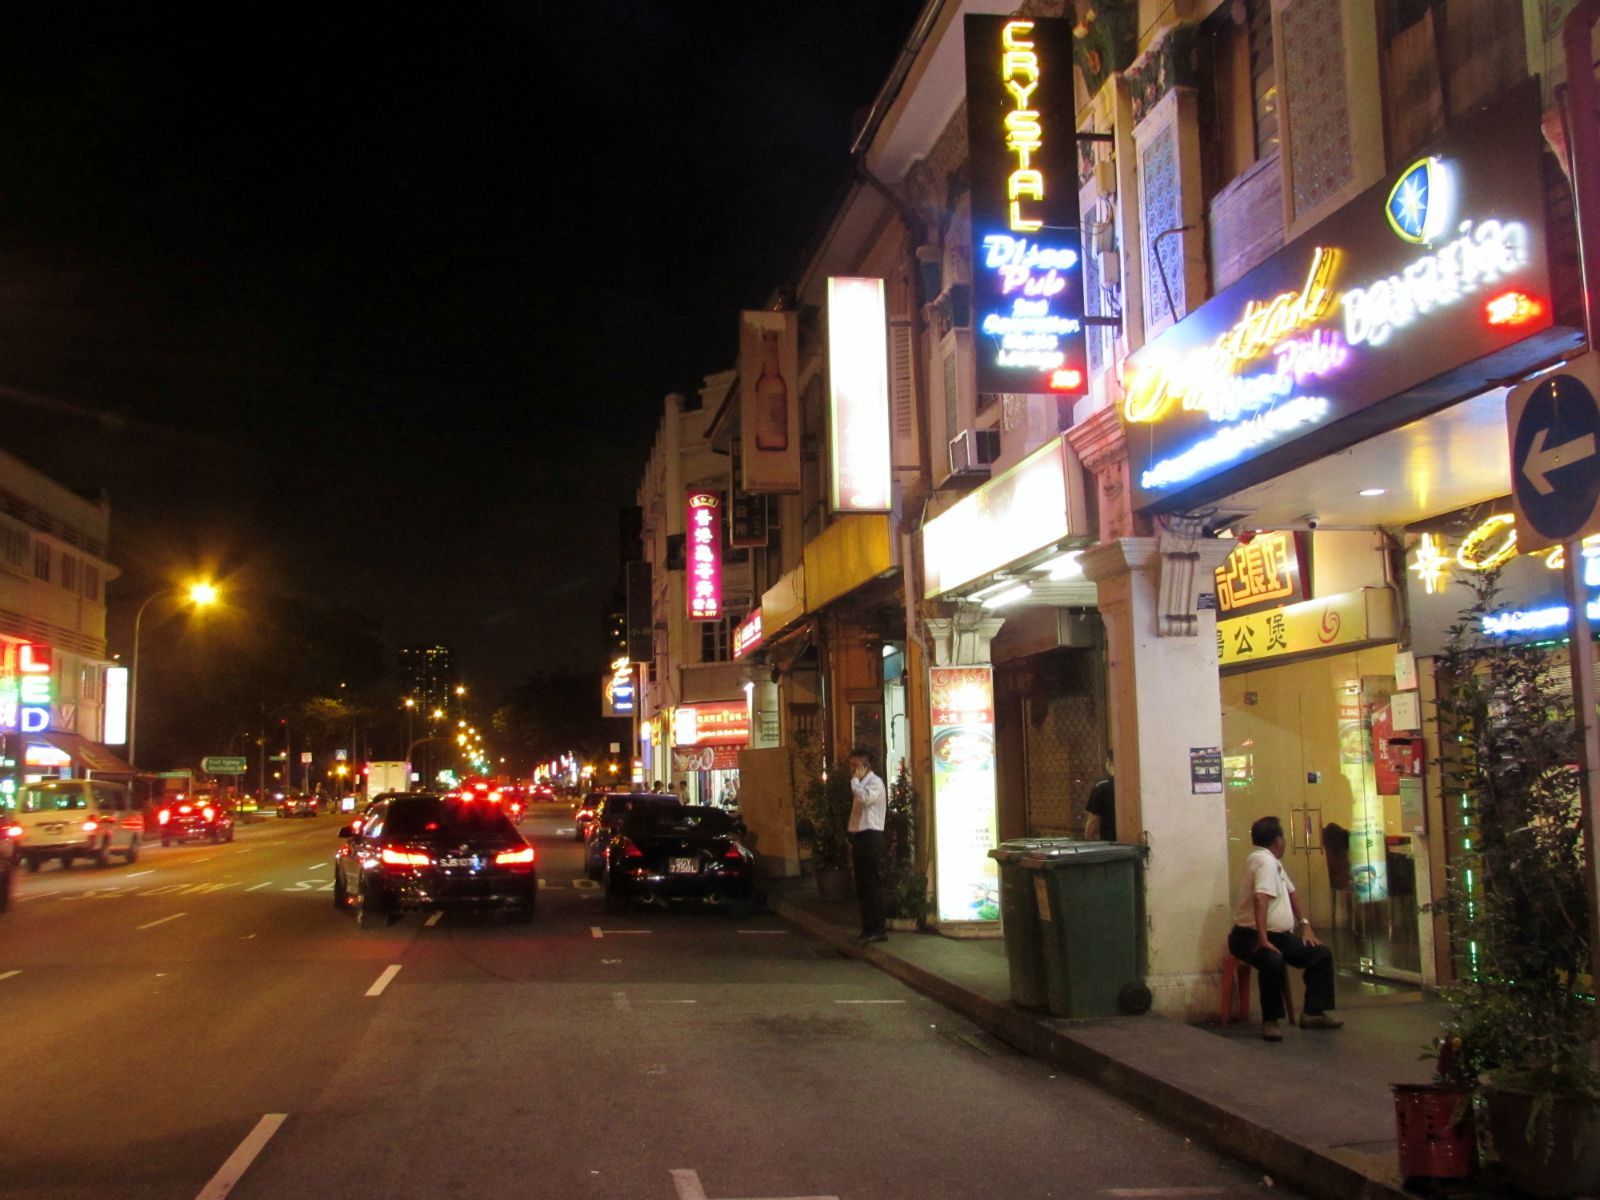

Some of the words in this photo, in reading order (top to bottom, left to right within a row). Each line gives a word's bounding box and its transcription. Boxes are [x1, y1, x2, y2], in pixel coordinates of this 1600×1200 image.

[1002, 20, 1043, 233] CRYSTAL
[983, 235, 1078, 269] Disco
[1000, 265, 1065, 297] Pub
[1125, 246, 1336, 422] Cstal
[20, 645, 51, 732] LED
[60, 881, 243, 901] SLOW
